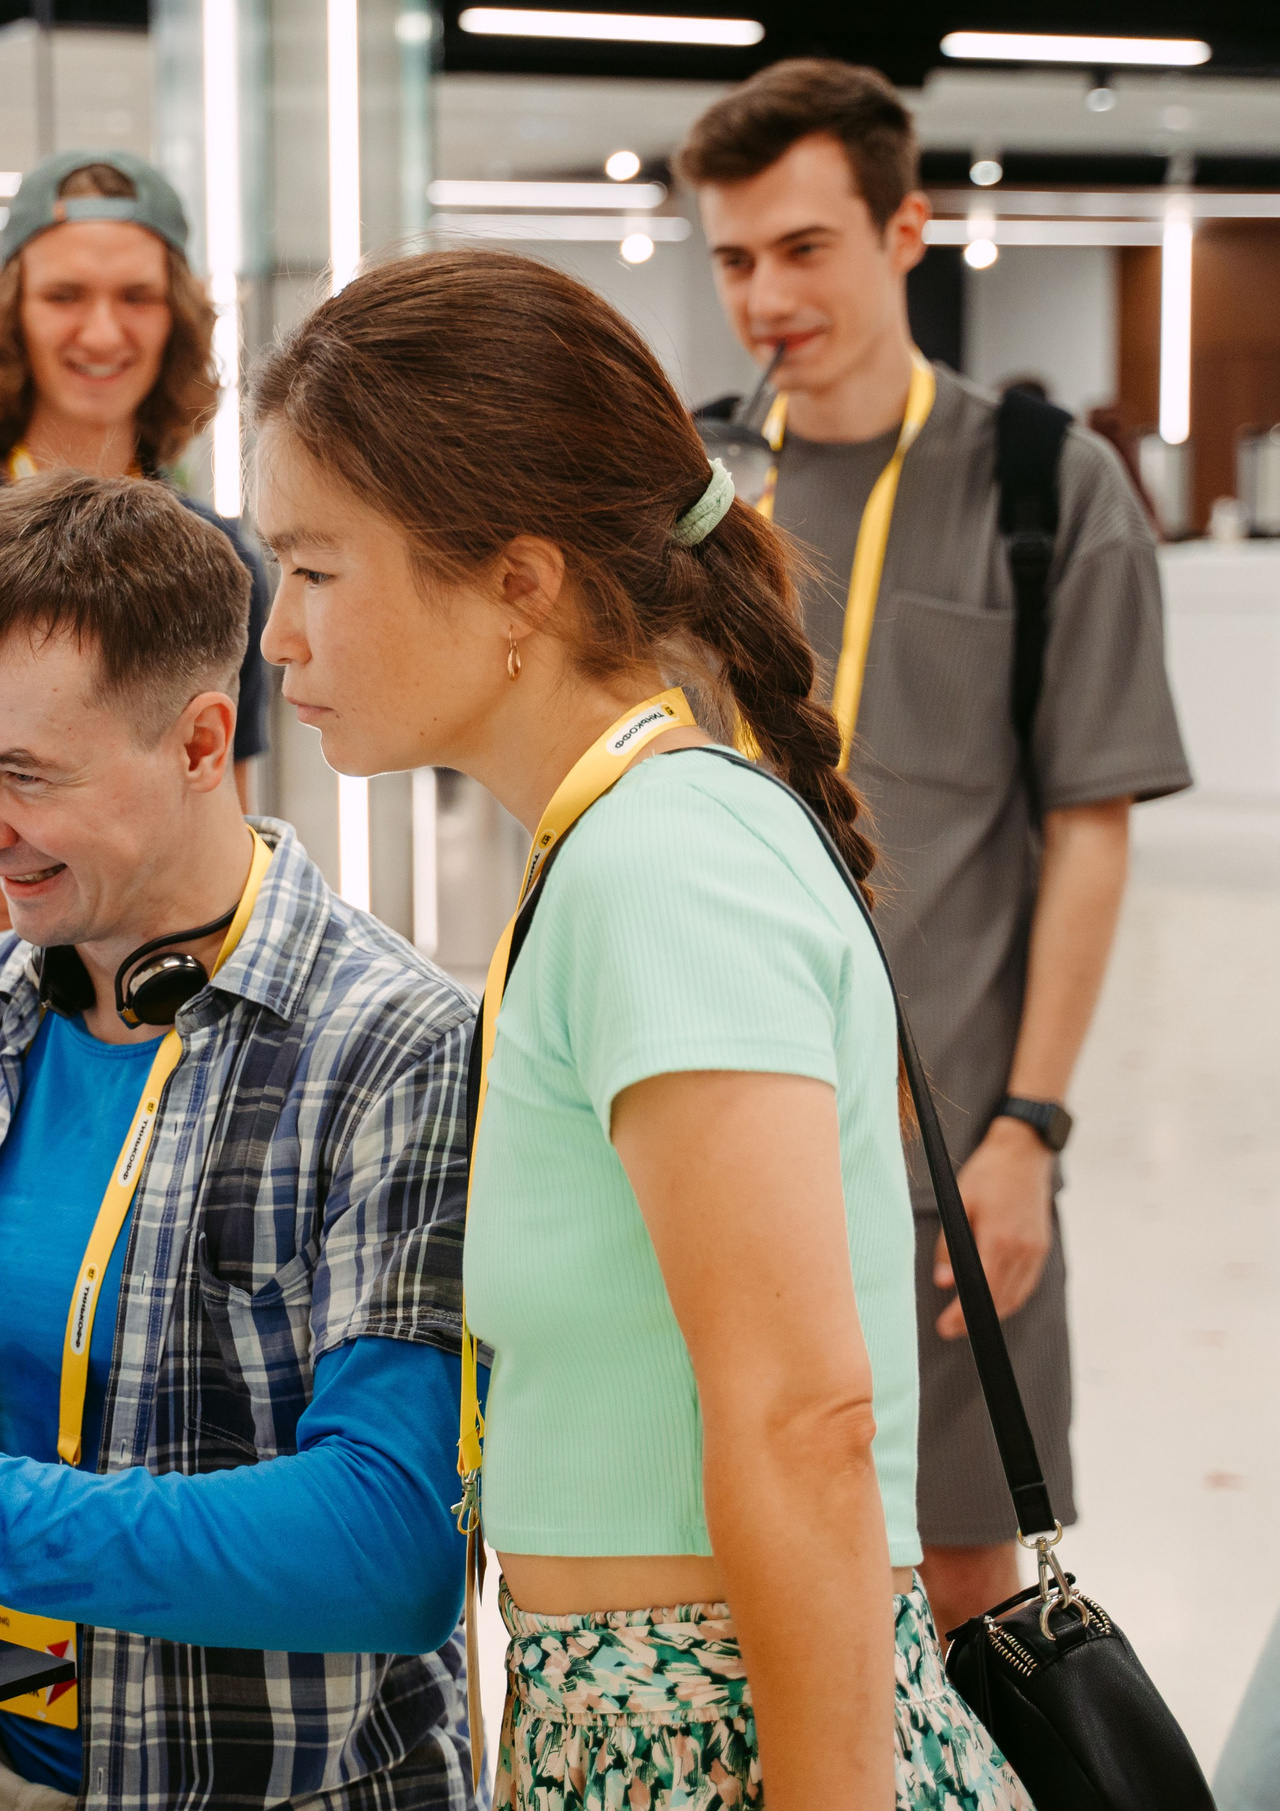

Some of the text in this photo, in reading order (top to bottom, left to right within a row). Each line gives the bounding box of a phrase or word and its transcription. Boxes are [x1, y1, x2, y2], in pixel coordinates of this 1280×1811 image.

[615, 712, 665, 748] ТИНЬКОФФ
[123, 1119, 149, 1180] ТИНЬКОФФ
[76, 1286, 90, 1348] ТИНЬКОФФ
